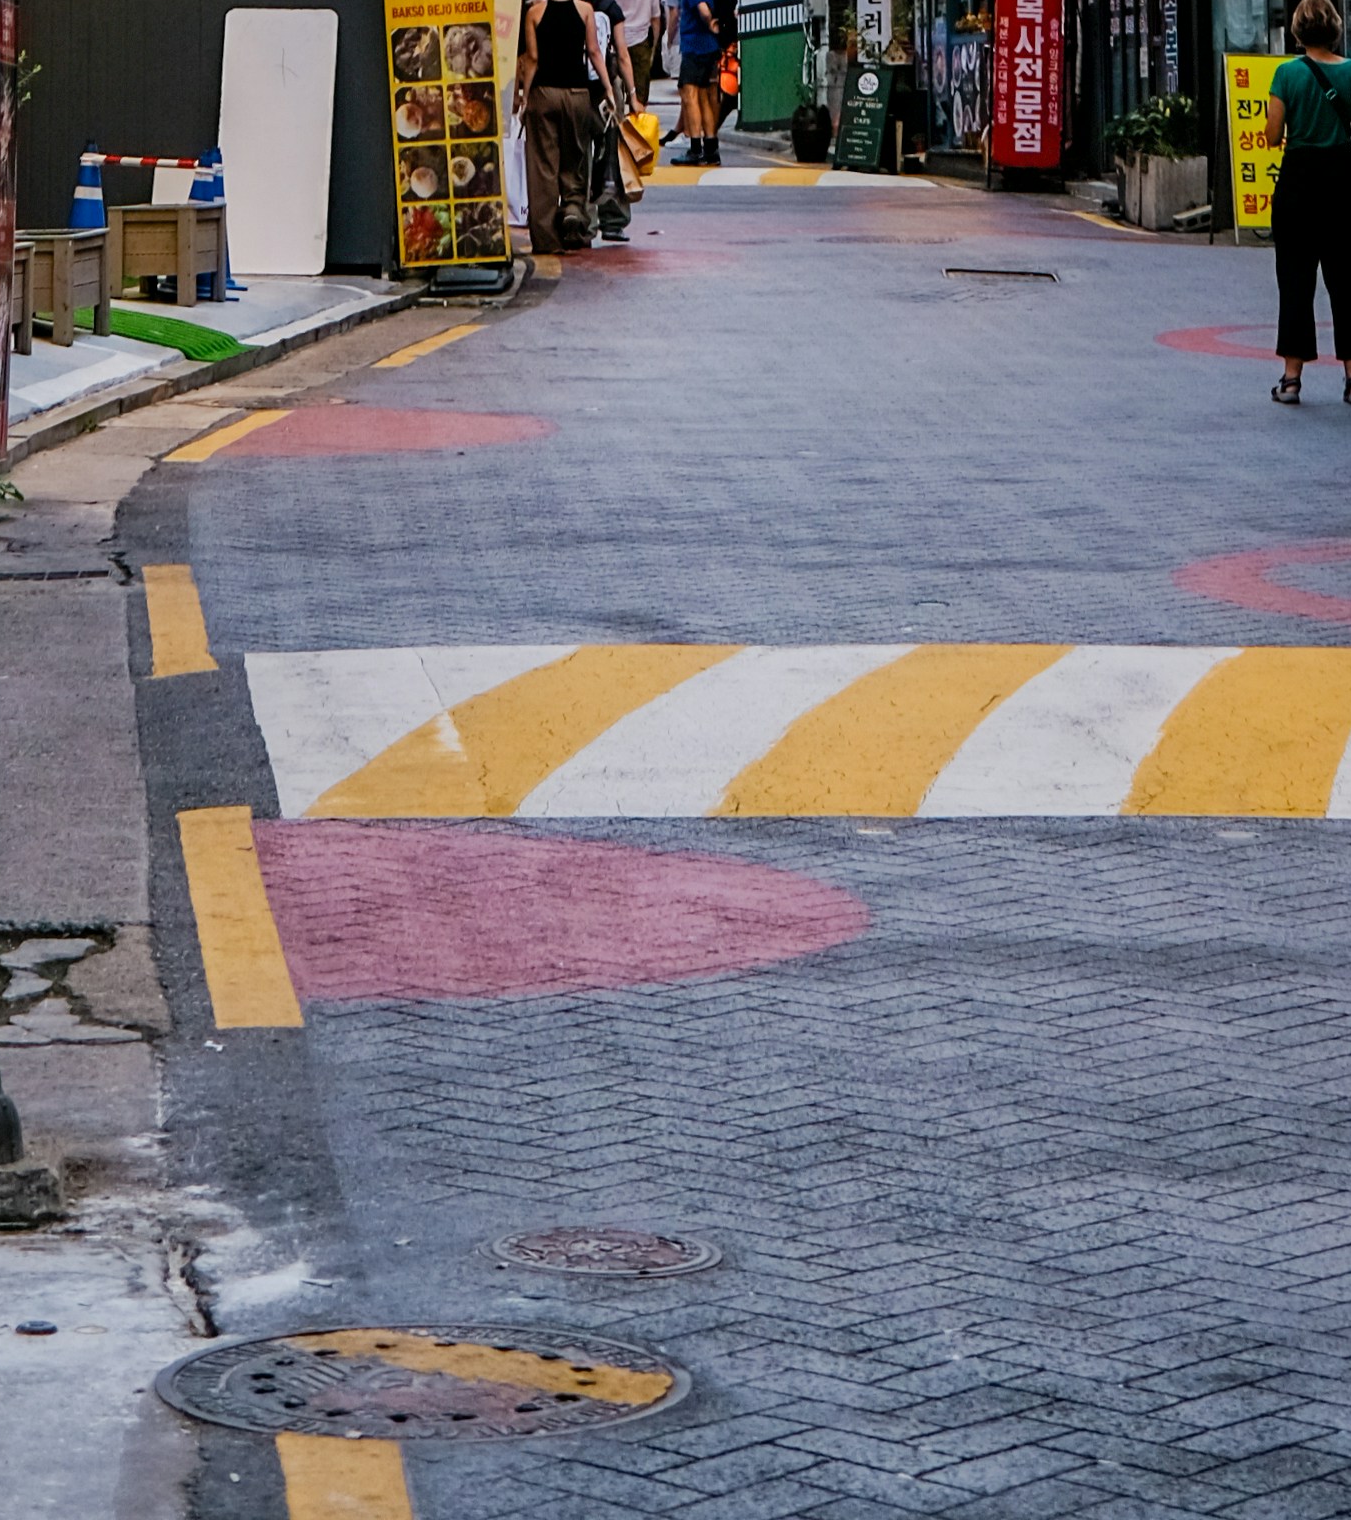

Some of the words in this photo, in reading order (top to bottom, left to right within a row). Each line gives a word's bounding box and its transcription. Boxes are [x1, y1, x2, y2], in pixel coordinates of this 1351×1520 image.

[392, 4, 425, 18] BAKSO
[428, 3, 452, 15] BEJO
[455, 1, 488, 13] KOREA
